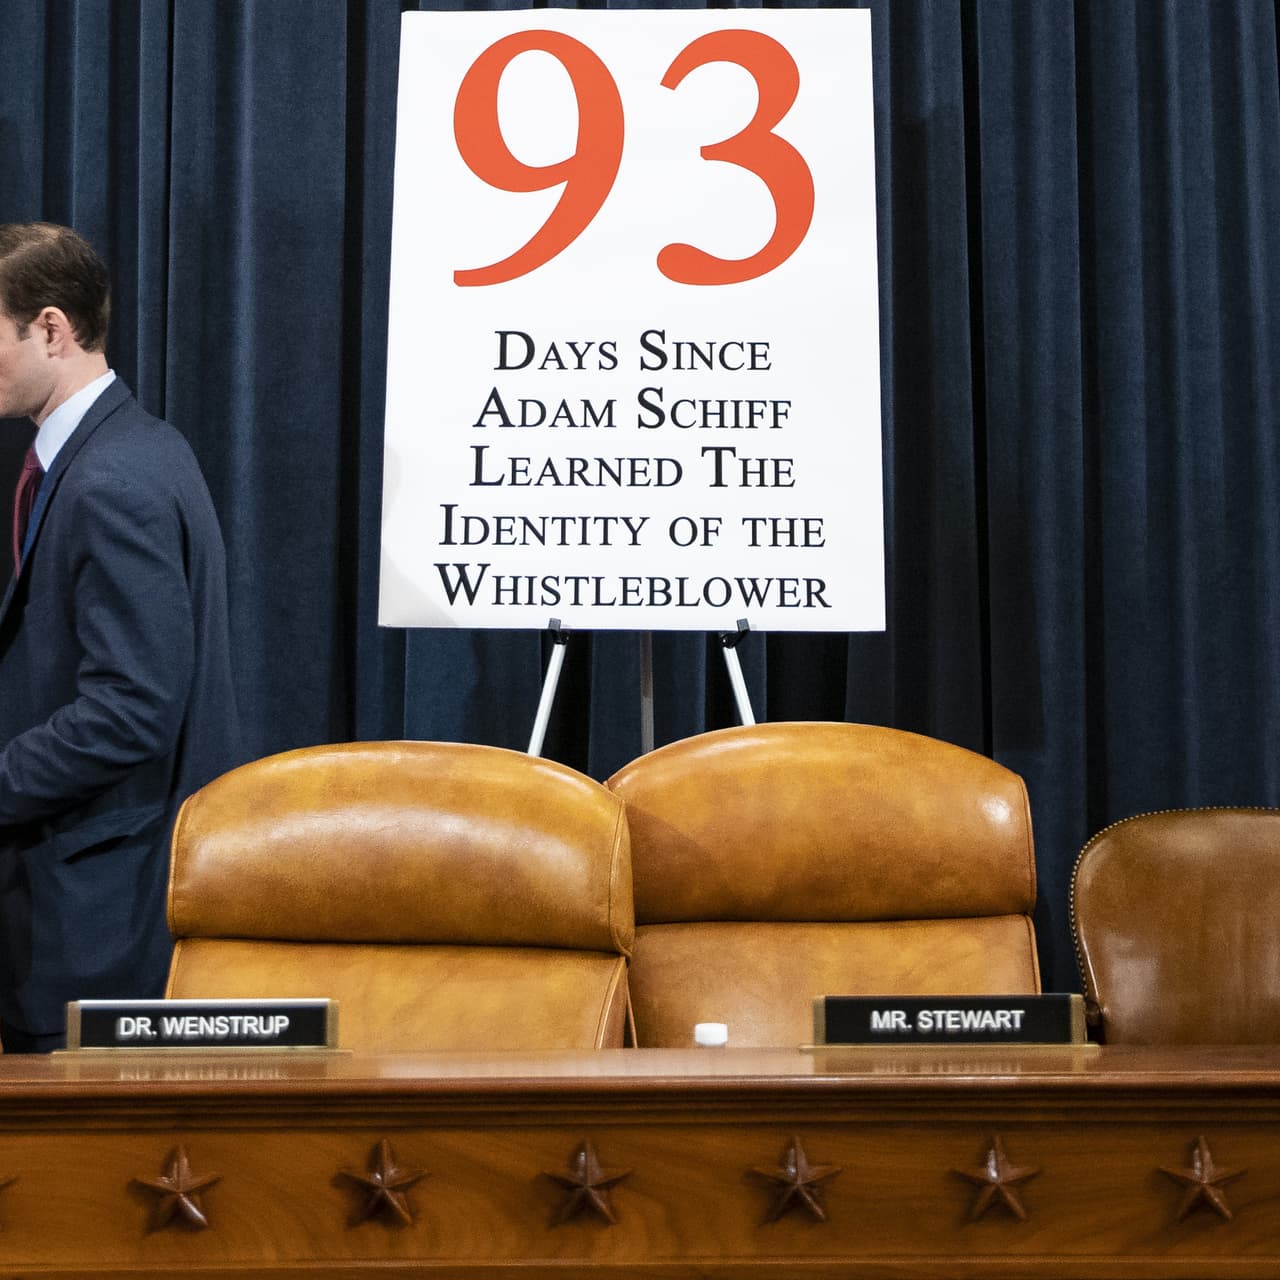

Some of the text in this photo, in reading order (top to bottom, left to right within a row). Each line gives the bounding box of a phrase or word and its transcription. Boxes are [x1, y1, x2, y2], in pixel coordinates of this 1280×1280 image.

[452, 28, 816, 288] 93
[119, 1015, 290, 1036] DR. WENSTRUP
[871, 1010, 1025, 1029] MR. STEWART
